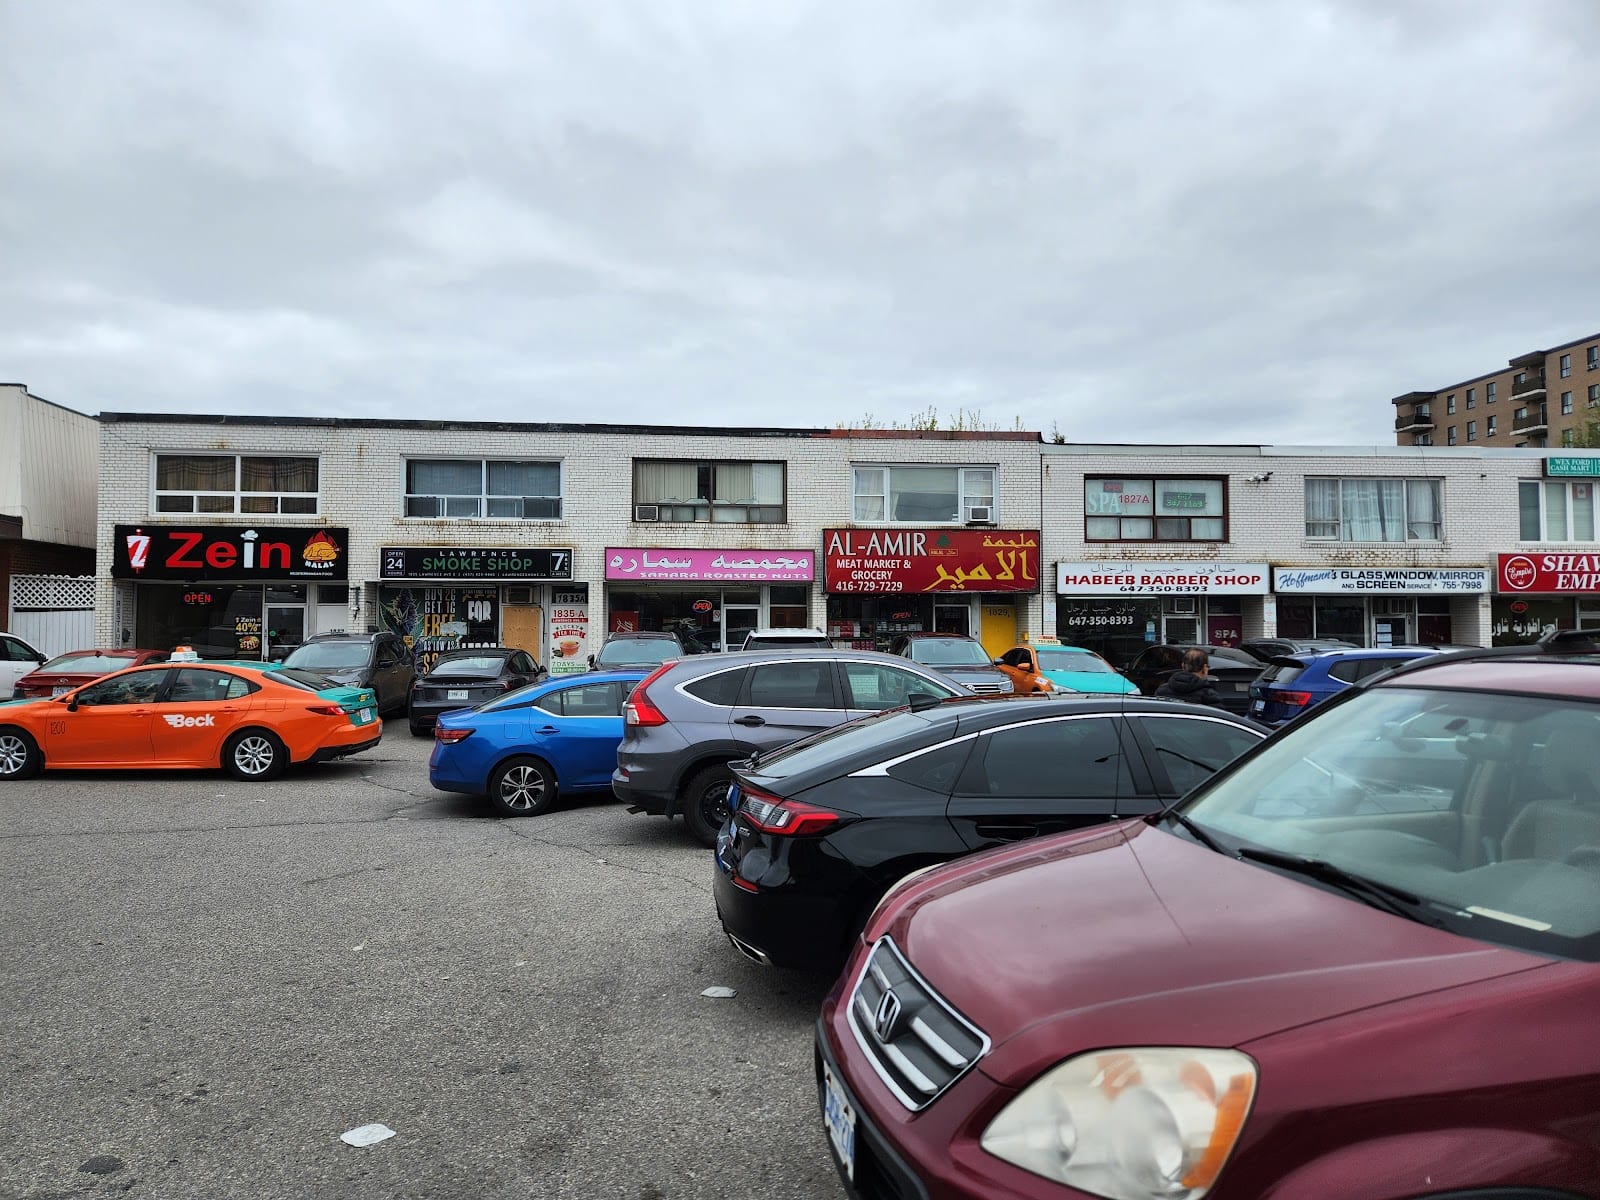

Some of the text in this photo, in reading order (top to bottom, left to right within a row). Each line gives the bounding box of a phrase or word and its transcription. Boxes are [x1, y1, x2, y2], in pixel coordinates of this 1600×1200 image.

[1119, 495, 1150, 503] 1827A
[165, 530, 291, 568] Zein
[827, 531, 928, 557] AL-AMIR
[305, 560, 335, 569] HALAL
[386, 558, 404, 569] 24
[422, 558, 532, 571] SMOKE SHOP
[551, 552, 565, 571] 7
[836, 559, 912, 569] MEAT MARKET &
[851, 571, 893, 580] GROCERY
[1508, 567, 1533, 580] Empire
[1065, 575, 1261, 585] HABEEB BARBER SHOP
[1279, 569, 1338, 590] Hoffmann's
[836, 581, 903, 592] 416-729-7229
[1356, 580, 1406, 589] SCREEN
[1440, 581, 1482, 590] 755-7998
[184, 593, 212, 603] OPEN
[424, 588, 443, 601] BUY
[424, 601, 443, 613] GET
[693, 601, 713, 611] OPEN
[891, 611, 912, 621] OPEN
[1068, 616, 1134, 626] 647-350-8393
[235, 622, 258, 632] 40%
[1214, 629, 1239, 639] SPA
[423, 640, 432, 651] AS
[432, 640, 446, 651] LOW
[172, 713, 216, 728] Beck
